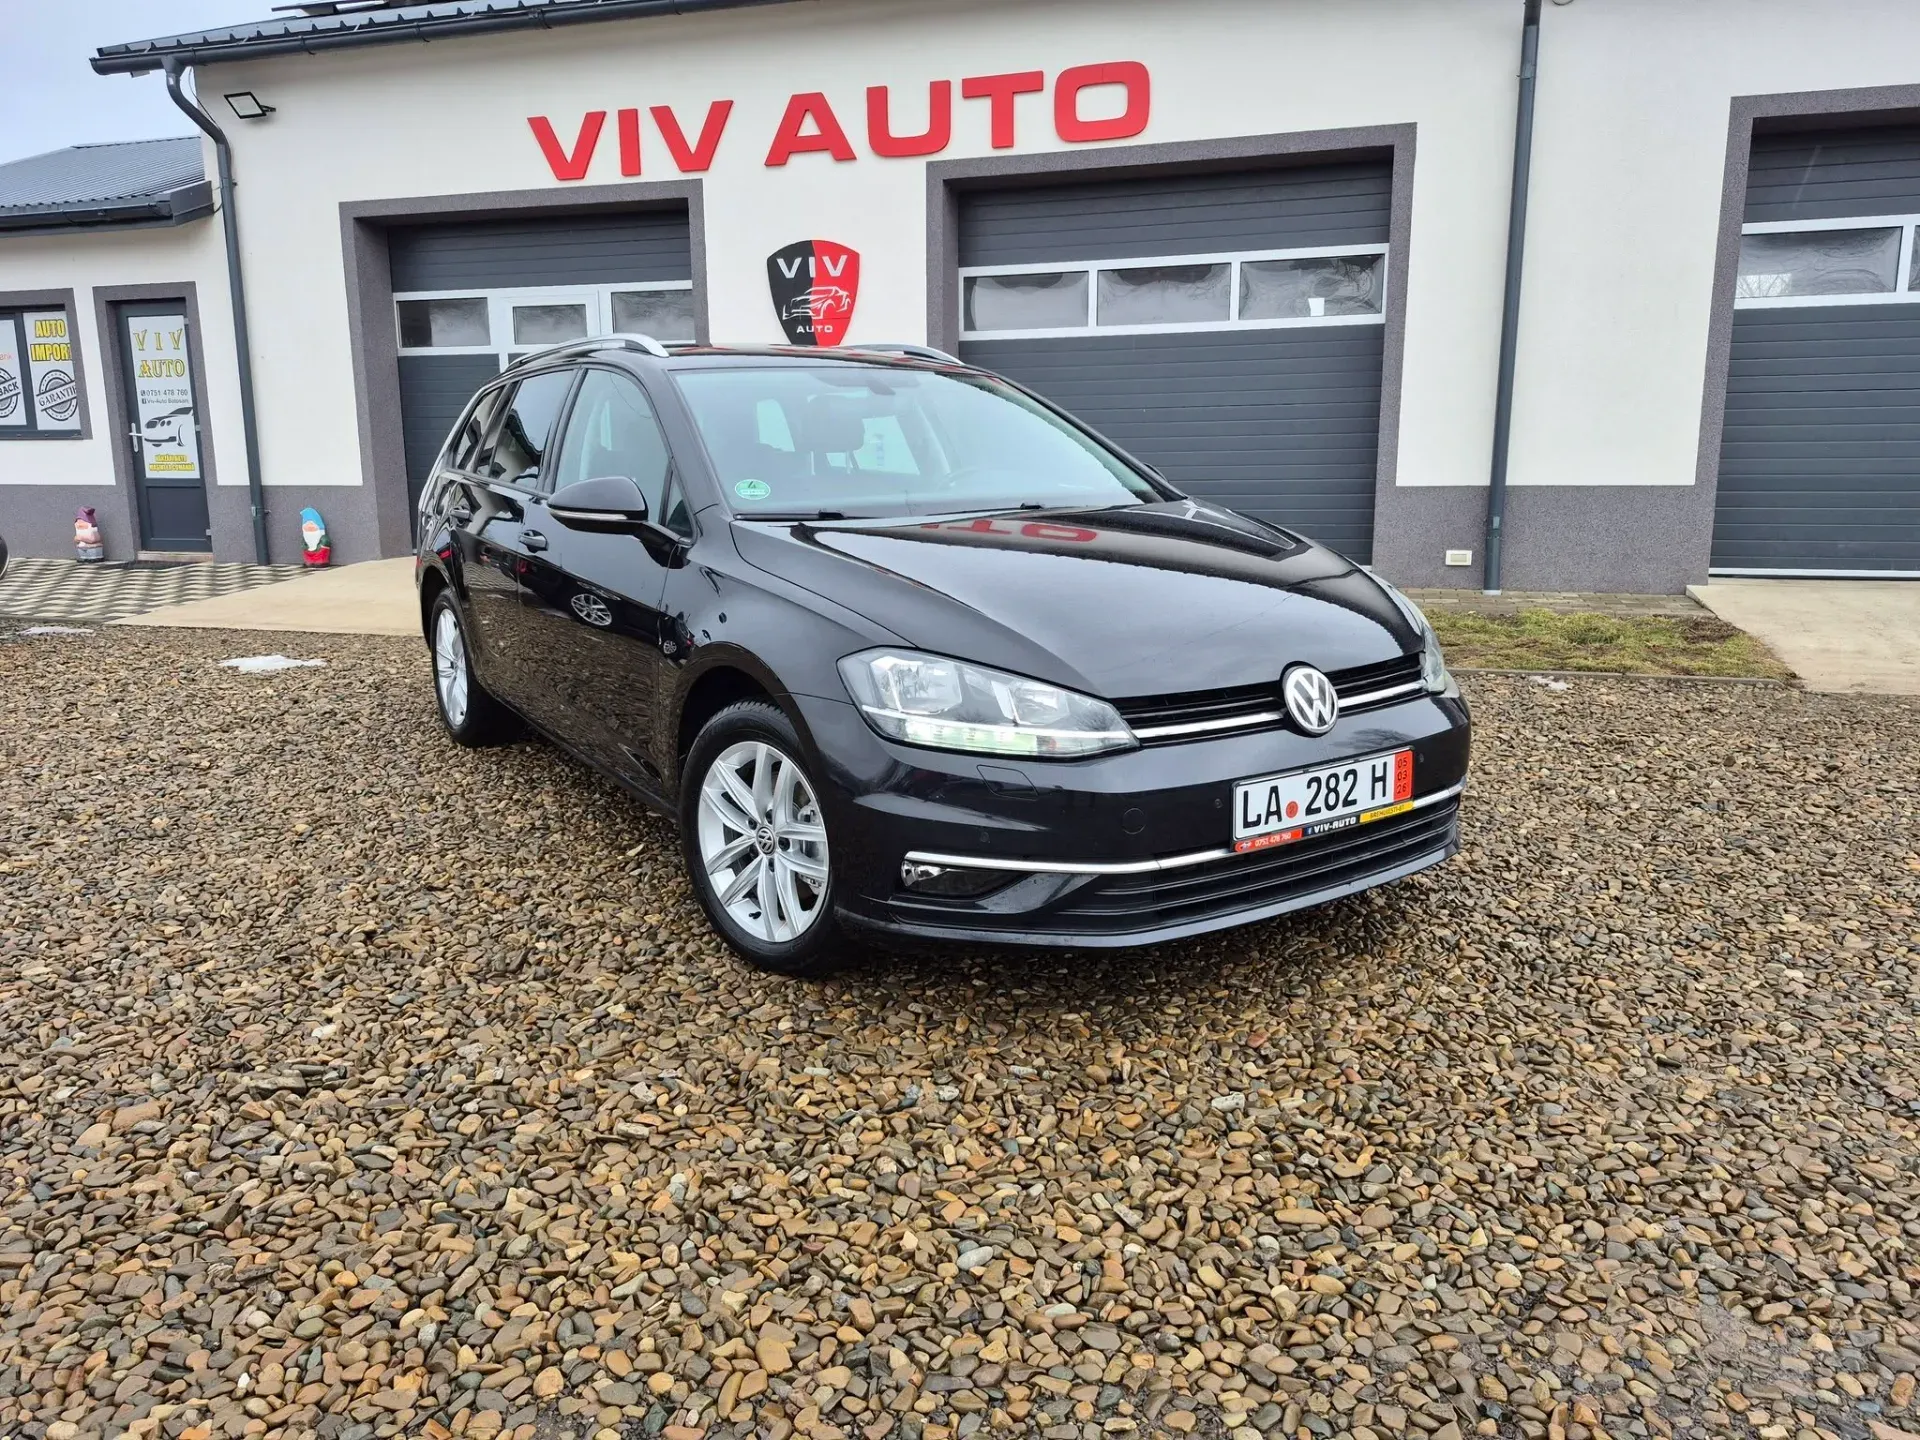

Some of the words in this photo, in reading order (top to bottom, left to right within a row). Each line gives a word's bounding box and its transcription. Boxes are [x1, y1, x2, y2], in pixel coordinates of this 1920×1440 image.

[527, 100, 734, 181] VIV
[764, 61, 1151, 167] AUTO
[776, 255, 848, 279] VIV
[34, 319, 66, 338] AUTO
[796, 325, 833, 333] AUTO
[138, 358, 186, 378] AUTO
[1242, 785, 1283, 829] LA
[1304, 768, 1358, 817] 282
[1371, 761, 1388, 801] H
[1313, 816, 1357, 834] VIV-AUTO
